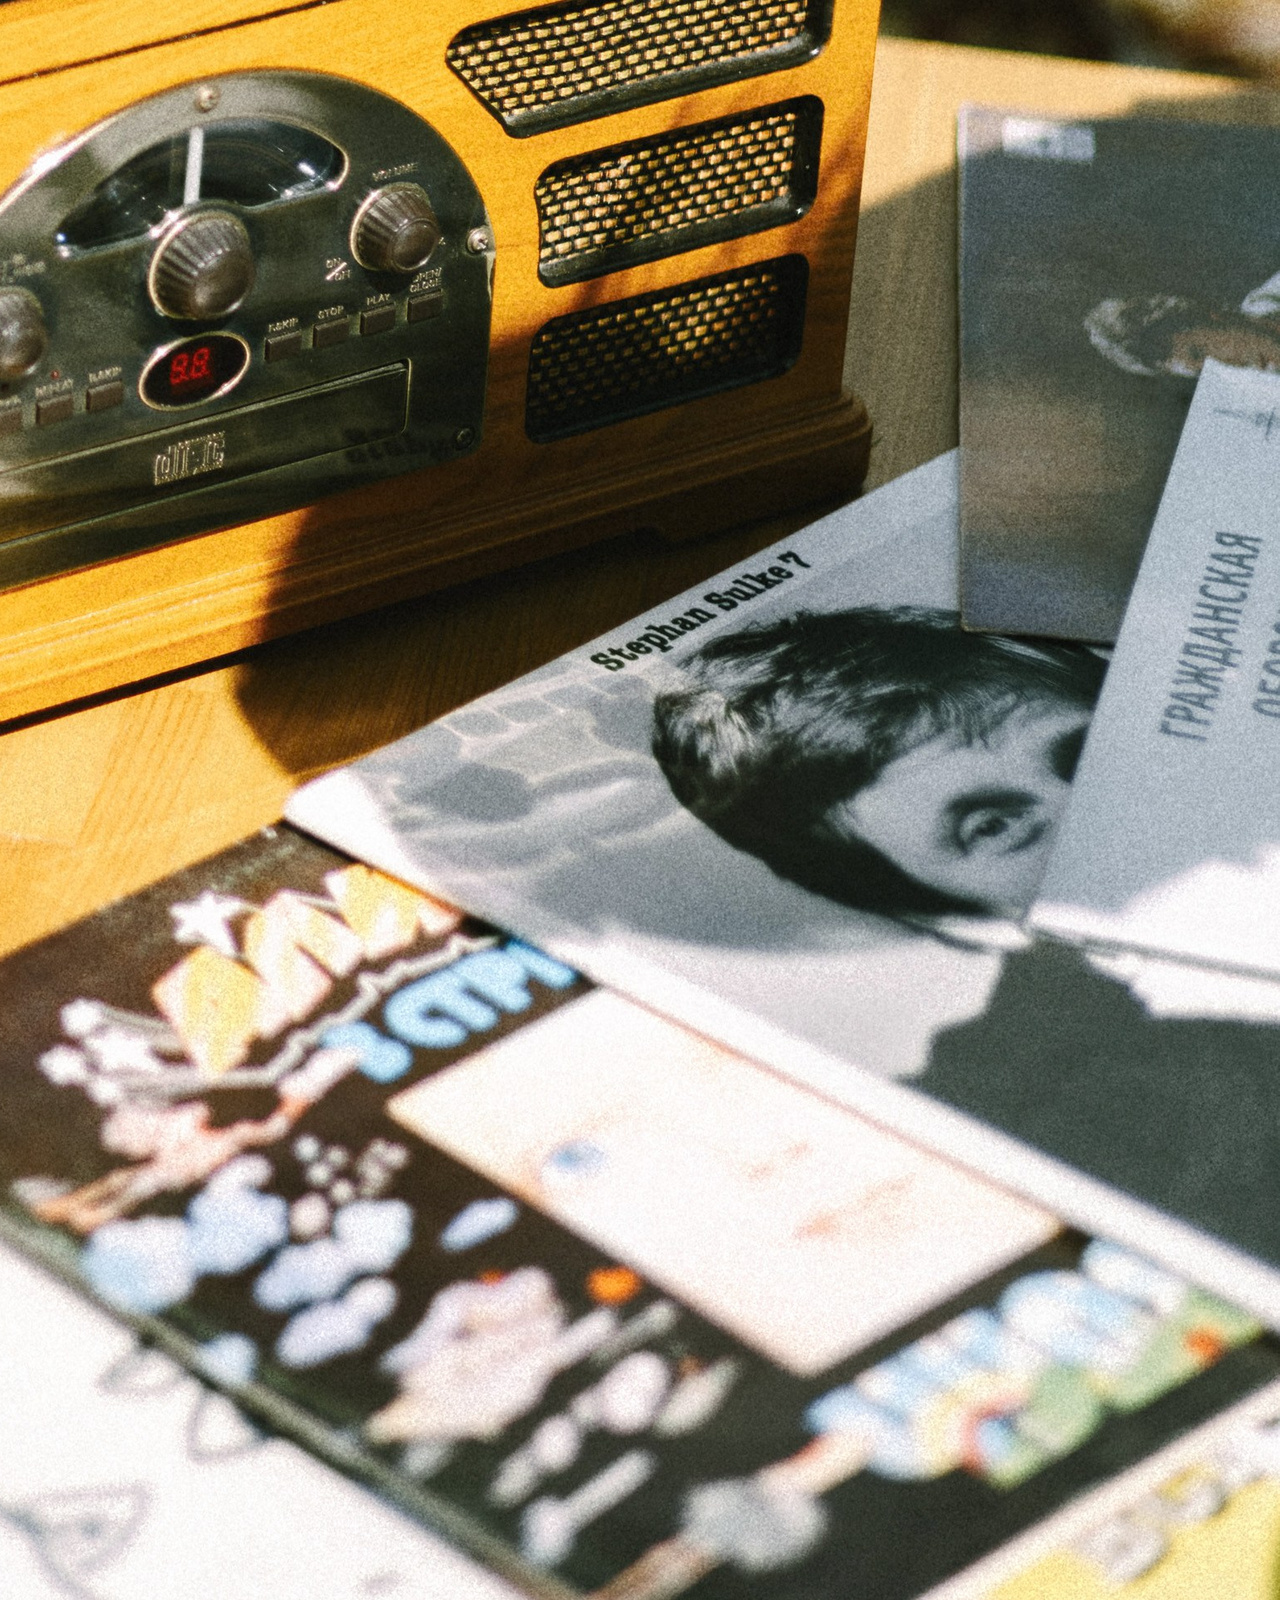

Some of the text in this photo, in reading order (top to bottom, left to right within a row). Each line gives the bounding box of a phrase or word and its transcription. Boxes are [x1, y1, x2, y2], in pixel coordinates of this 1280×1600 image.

[318, 305, 344, 319] STOP
[367, 293, 391, 305] PLAY
[590, 551, 811, 672] Stephan Sulke 7
[1158, 532, 1265, 742] ГРАЖДАНСКАЯ
